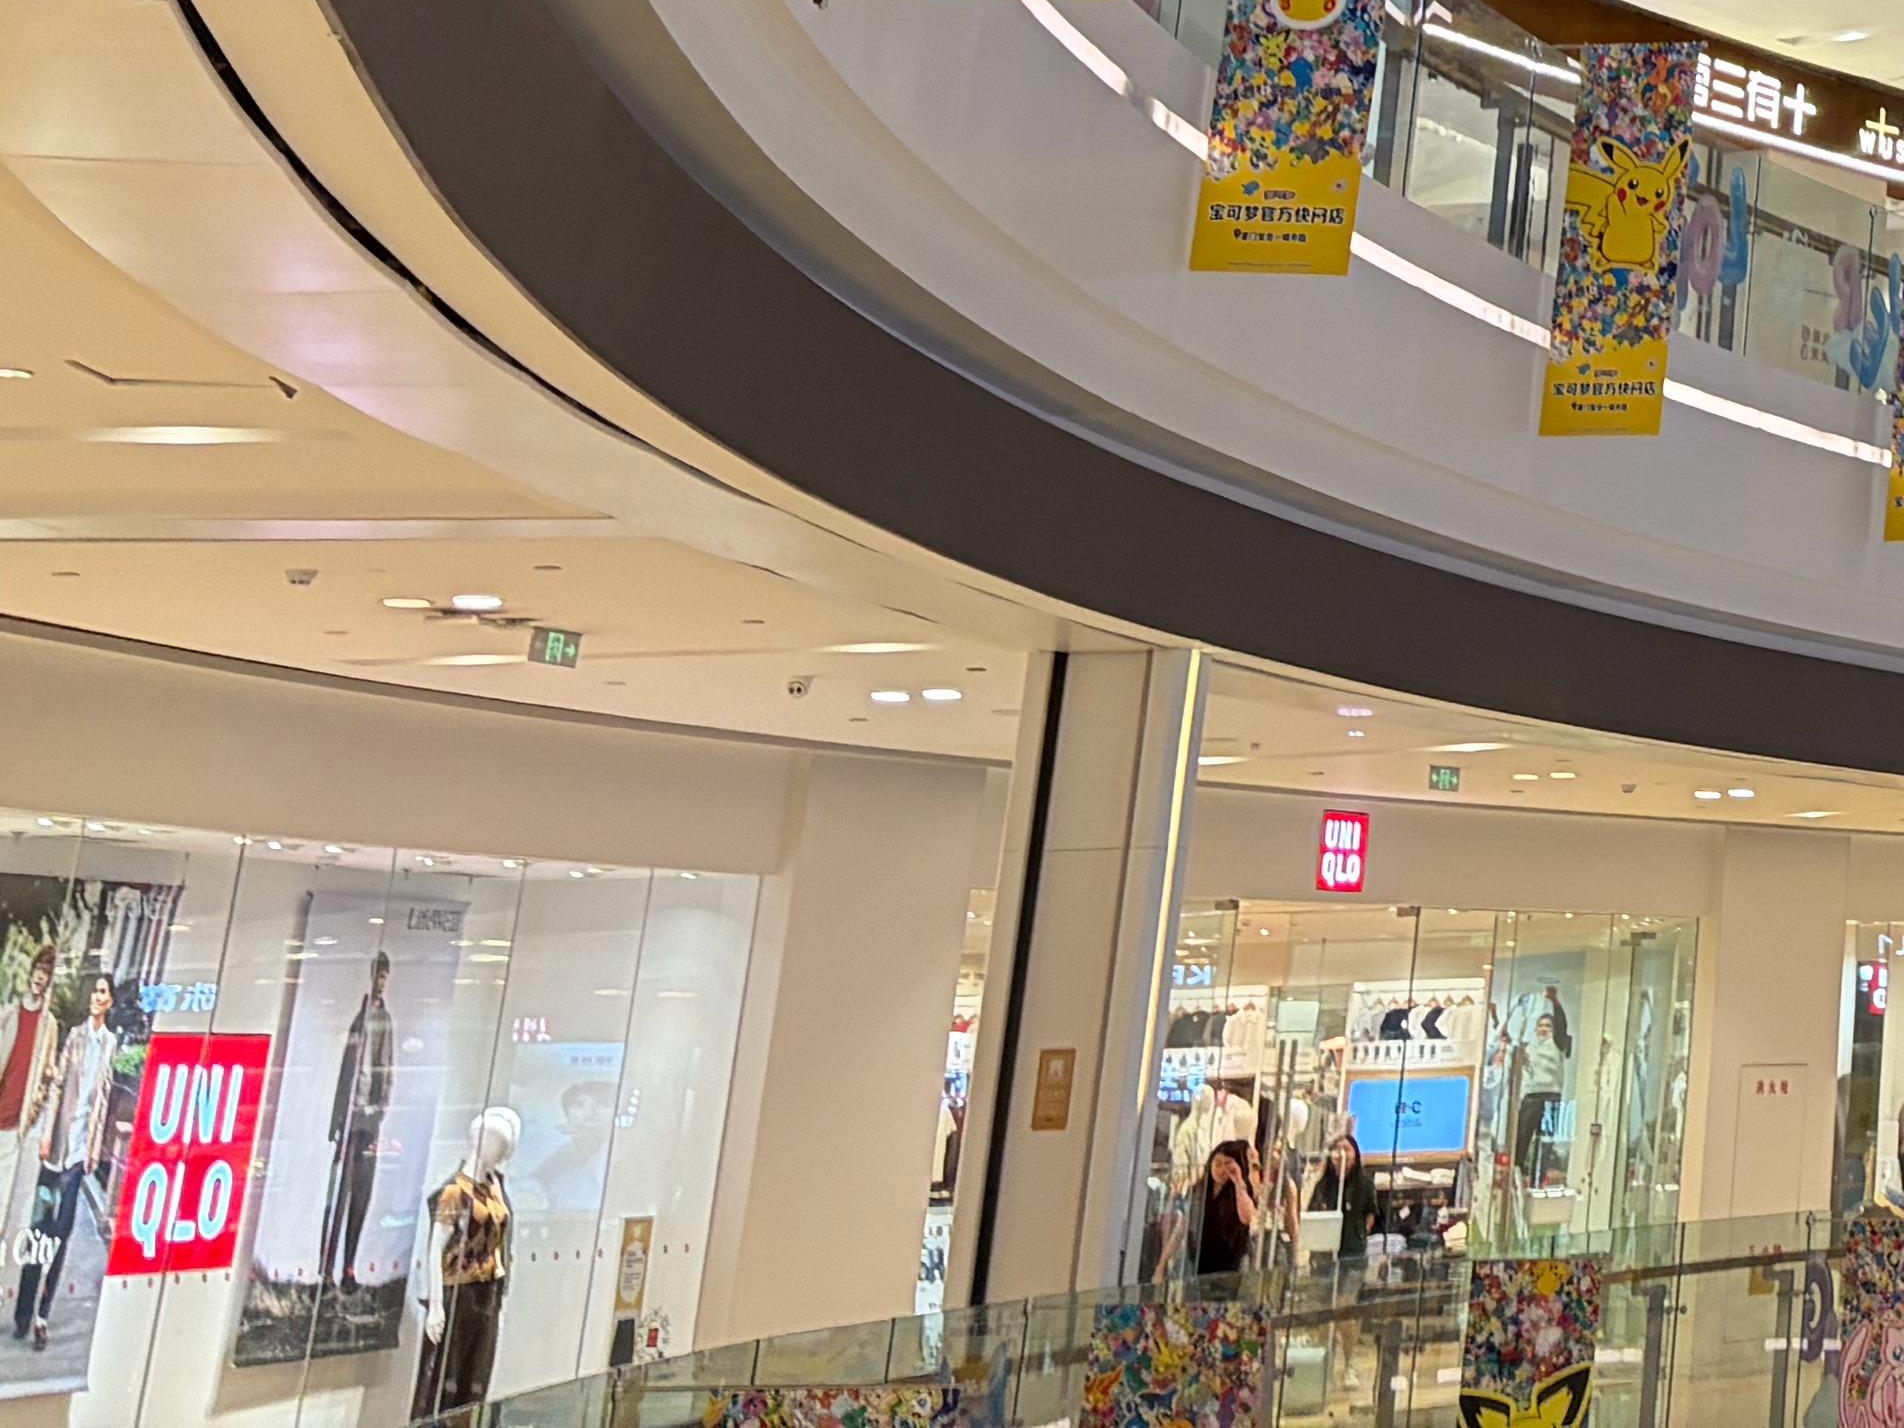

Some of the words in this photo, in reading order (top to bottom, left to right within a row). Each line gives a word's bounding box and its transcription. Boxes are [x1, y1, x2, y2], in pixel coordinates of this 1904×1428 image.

[1324, 819, 1361, 850] UNI
[1321, 850, 1361, 887] QLO
[149, 1062, 244, 1145] UNI
[130, 1159, 234, 1258] QLO
[12, 1227, 61, 1269] City
